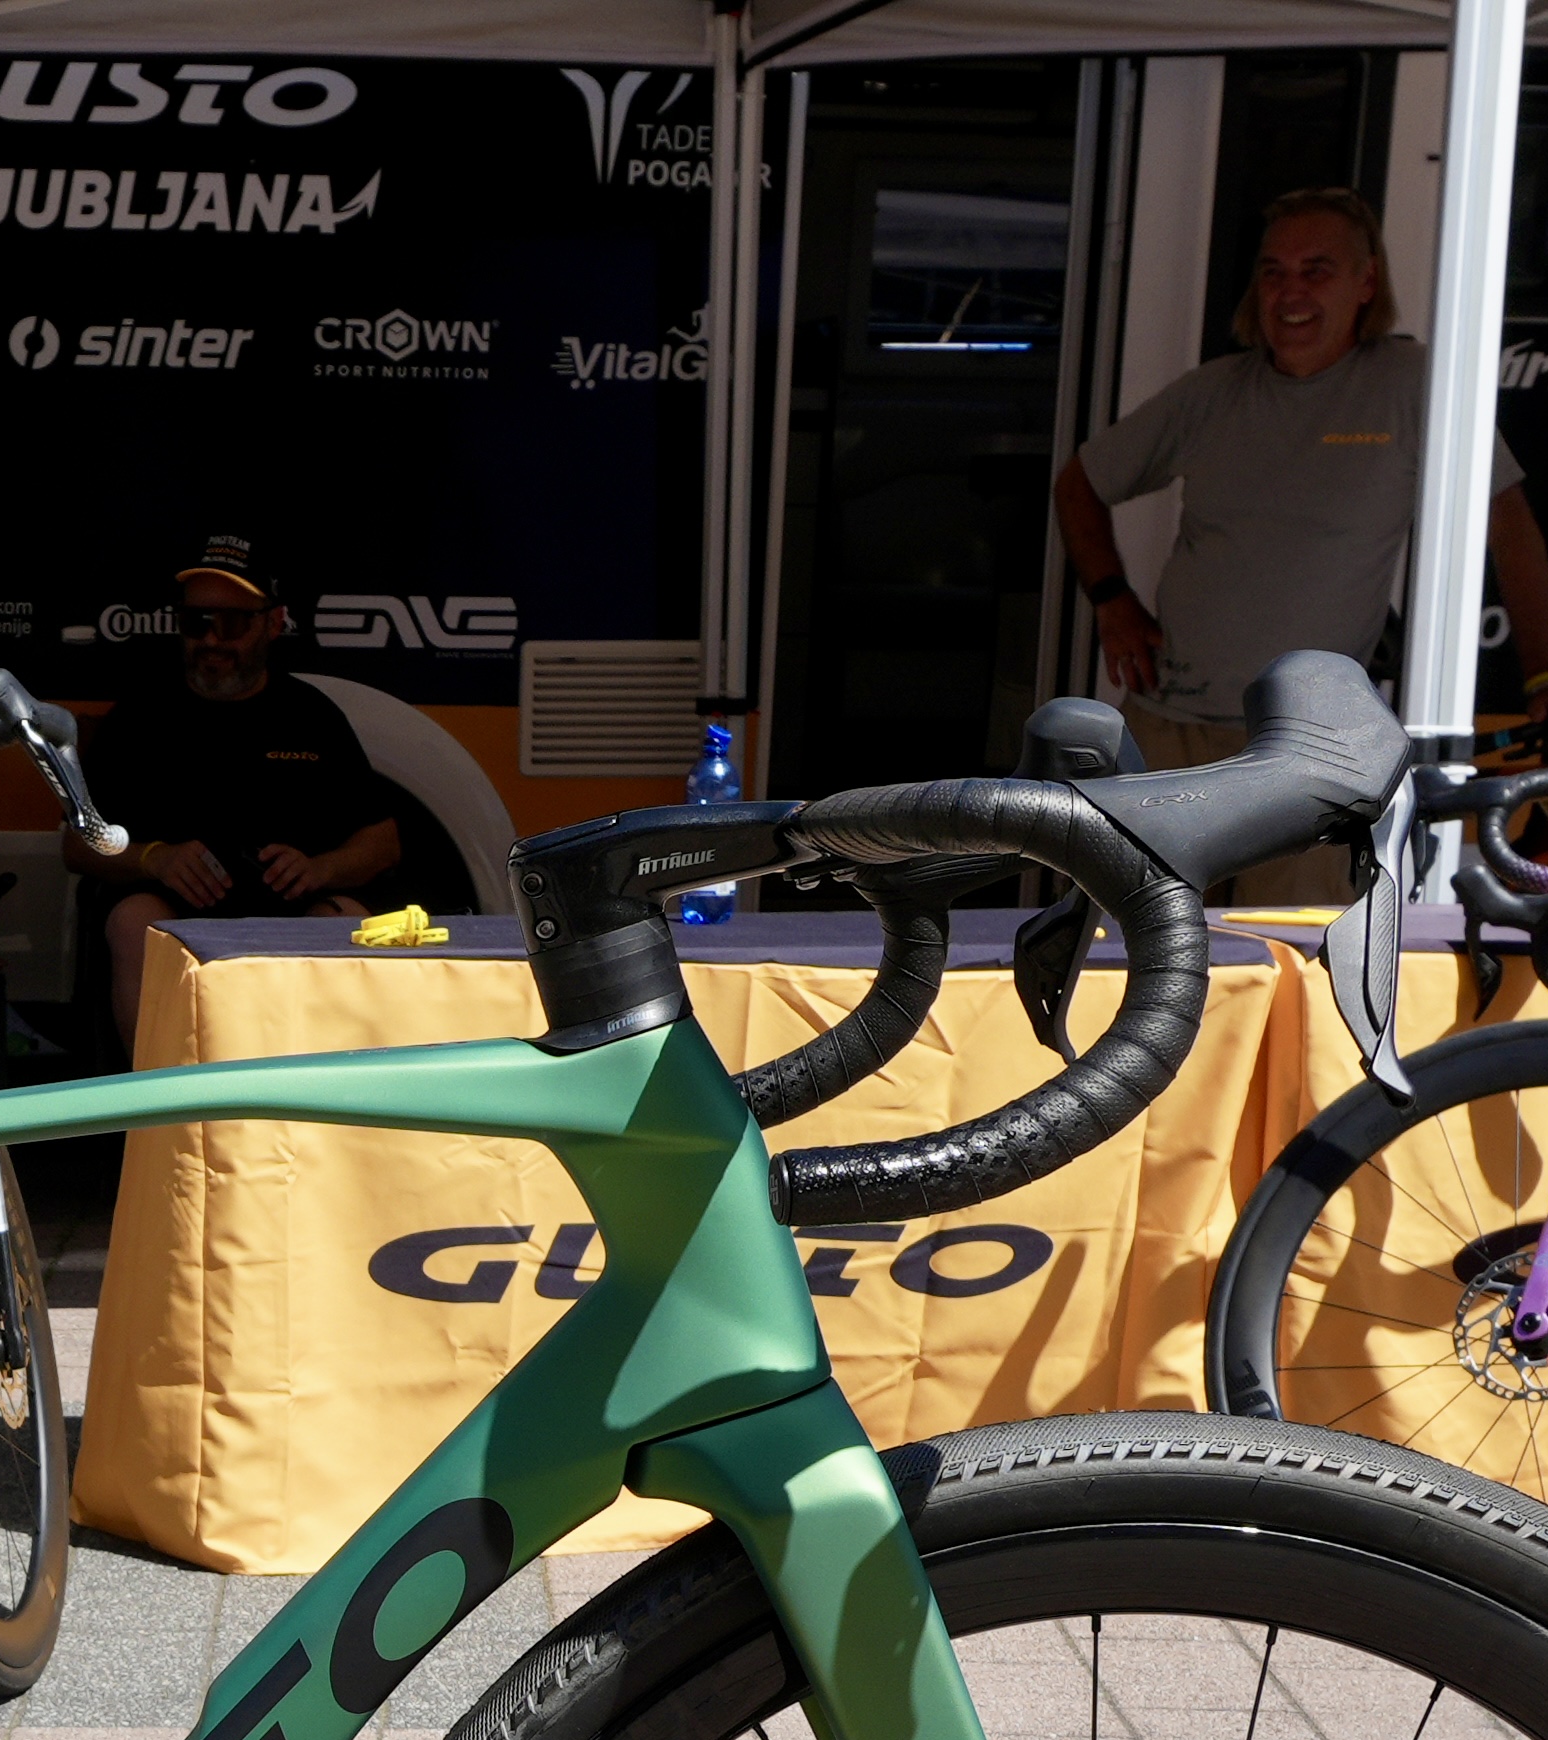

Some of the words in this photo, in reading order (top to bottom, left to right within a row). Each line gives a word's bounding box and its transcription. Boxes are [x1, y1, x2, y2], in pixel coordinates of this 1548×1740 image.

[636, 124, 712, 152] TADE
[628, 160, 772, 189] POGAR
[74, 319, 253, 369] sinter
[314, 308, 490, 361] CROWN
[314, 364, 375, 378] SPORT
[382, 365, 490, 379] NUTRITION
[561, 336, 708, 381] VitalG
[1140, 790, 1208, 808] GRX
[368, 1224, 1053, 1304] GUTO
